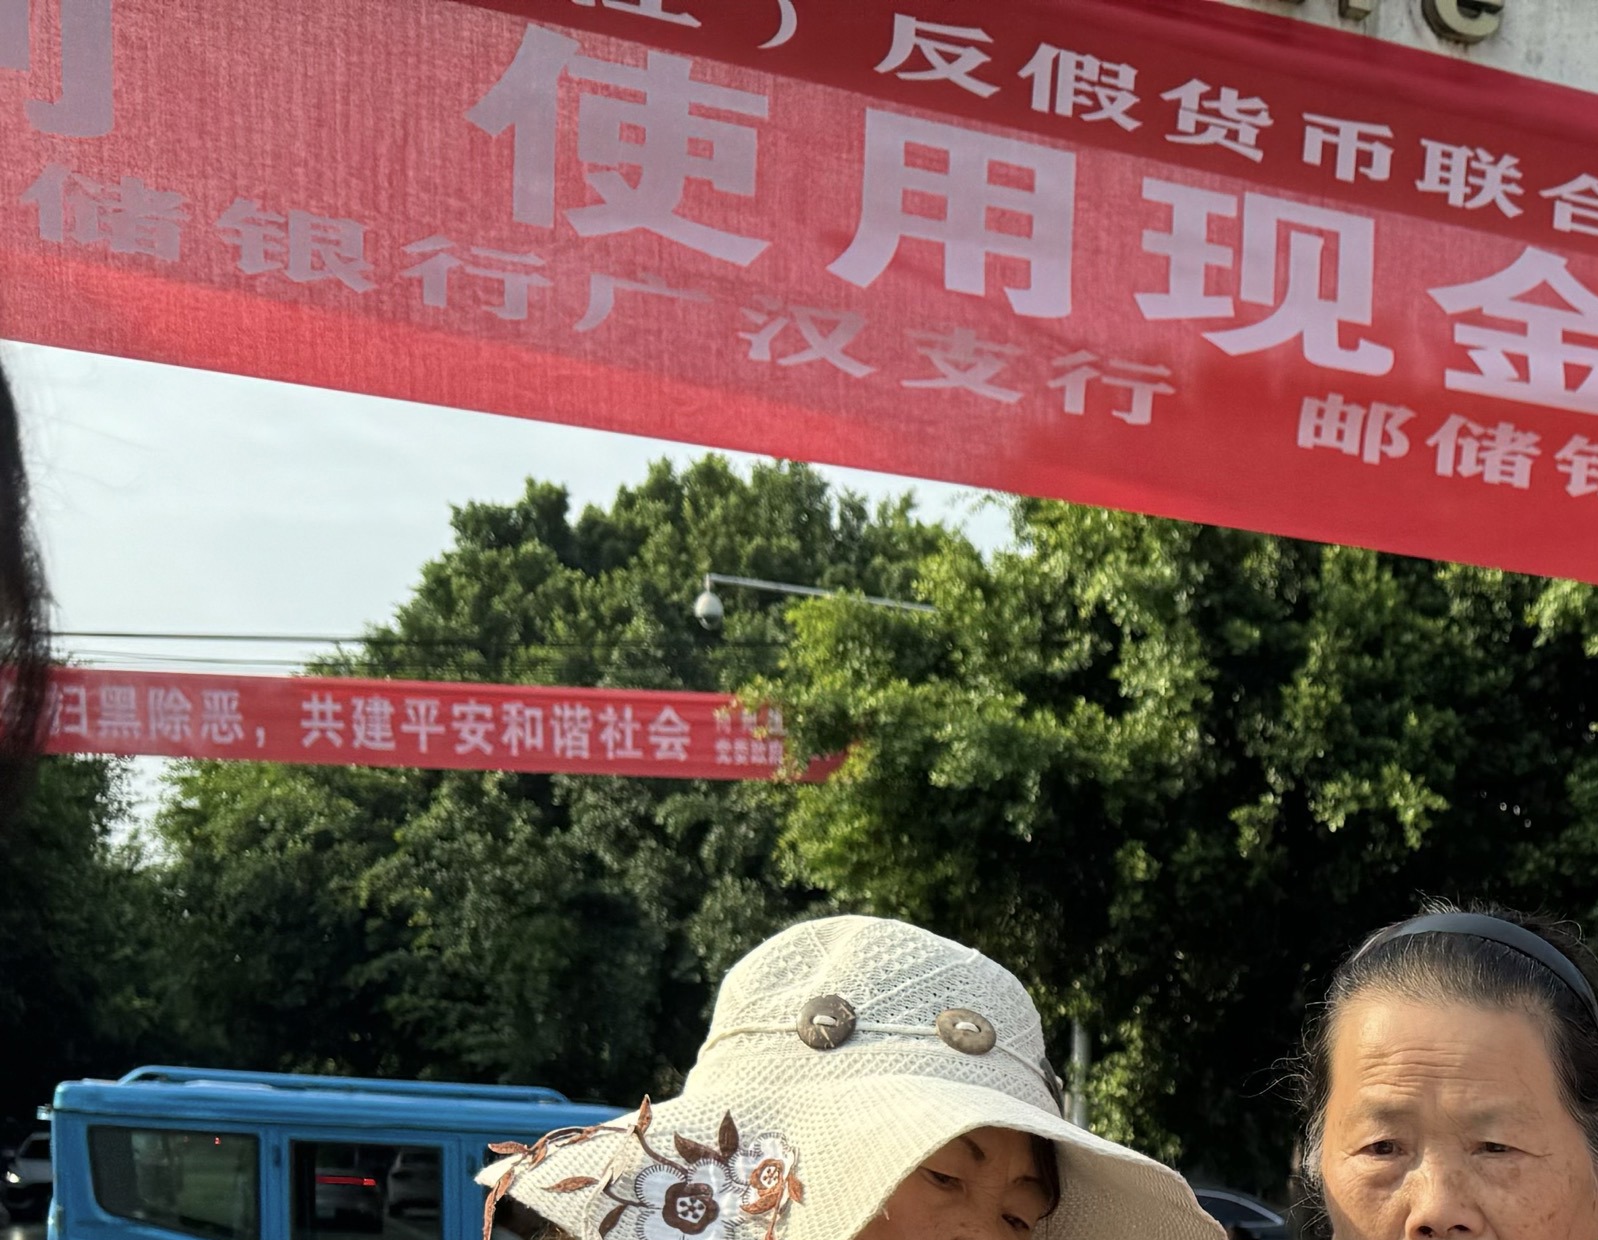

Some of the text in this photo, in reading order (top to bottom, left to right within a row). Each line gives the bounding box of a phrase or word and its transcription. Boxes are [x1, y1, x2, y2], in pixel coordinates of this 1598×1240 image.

[18, 162, 1176, 427] 储银行广汉支行
